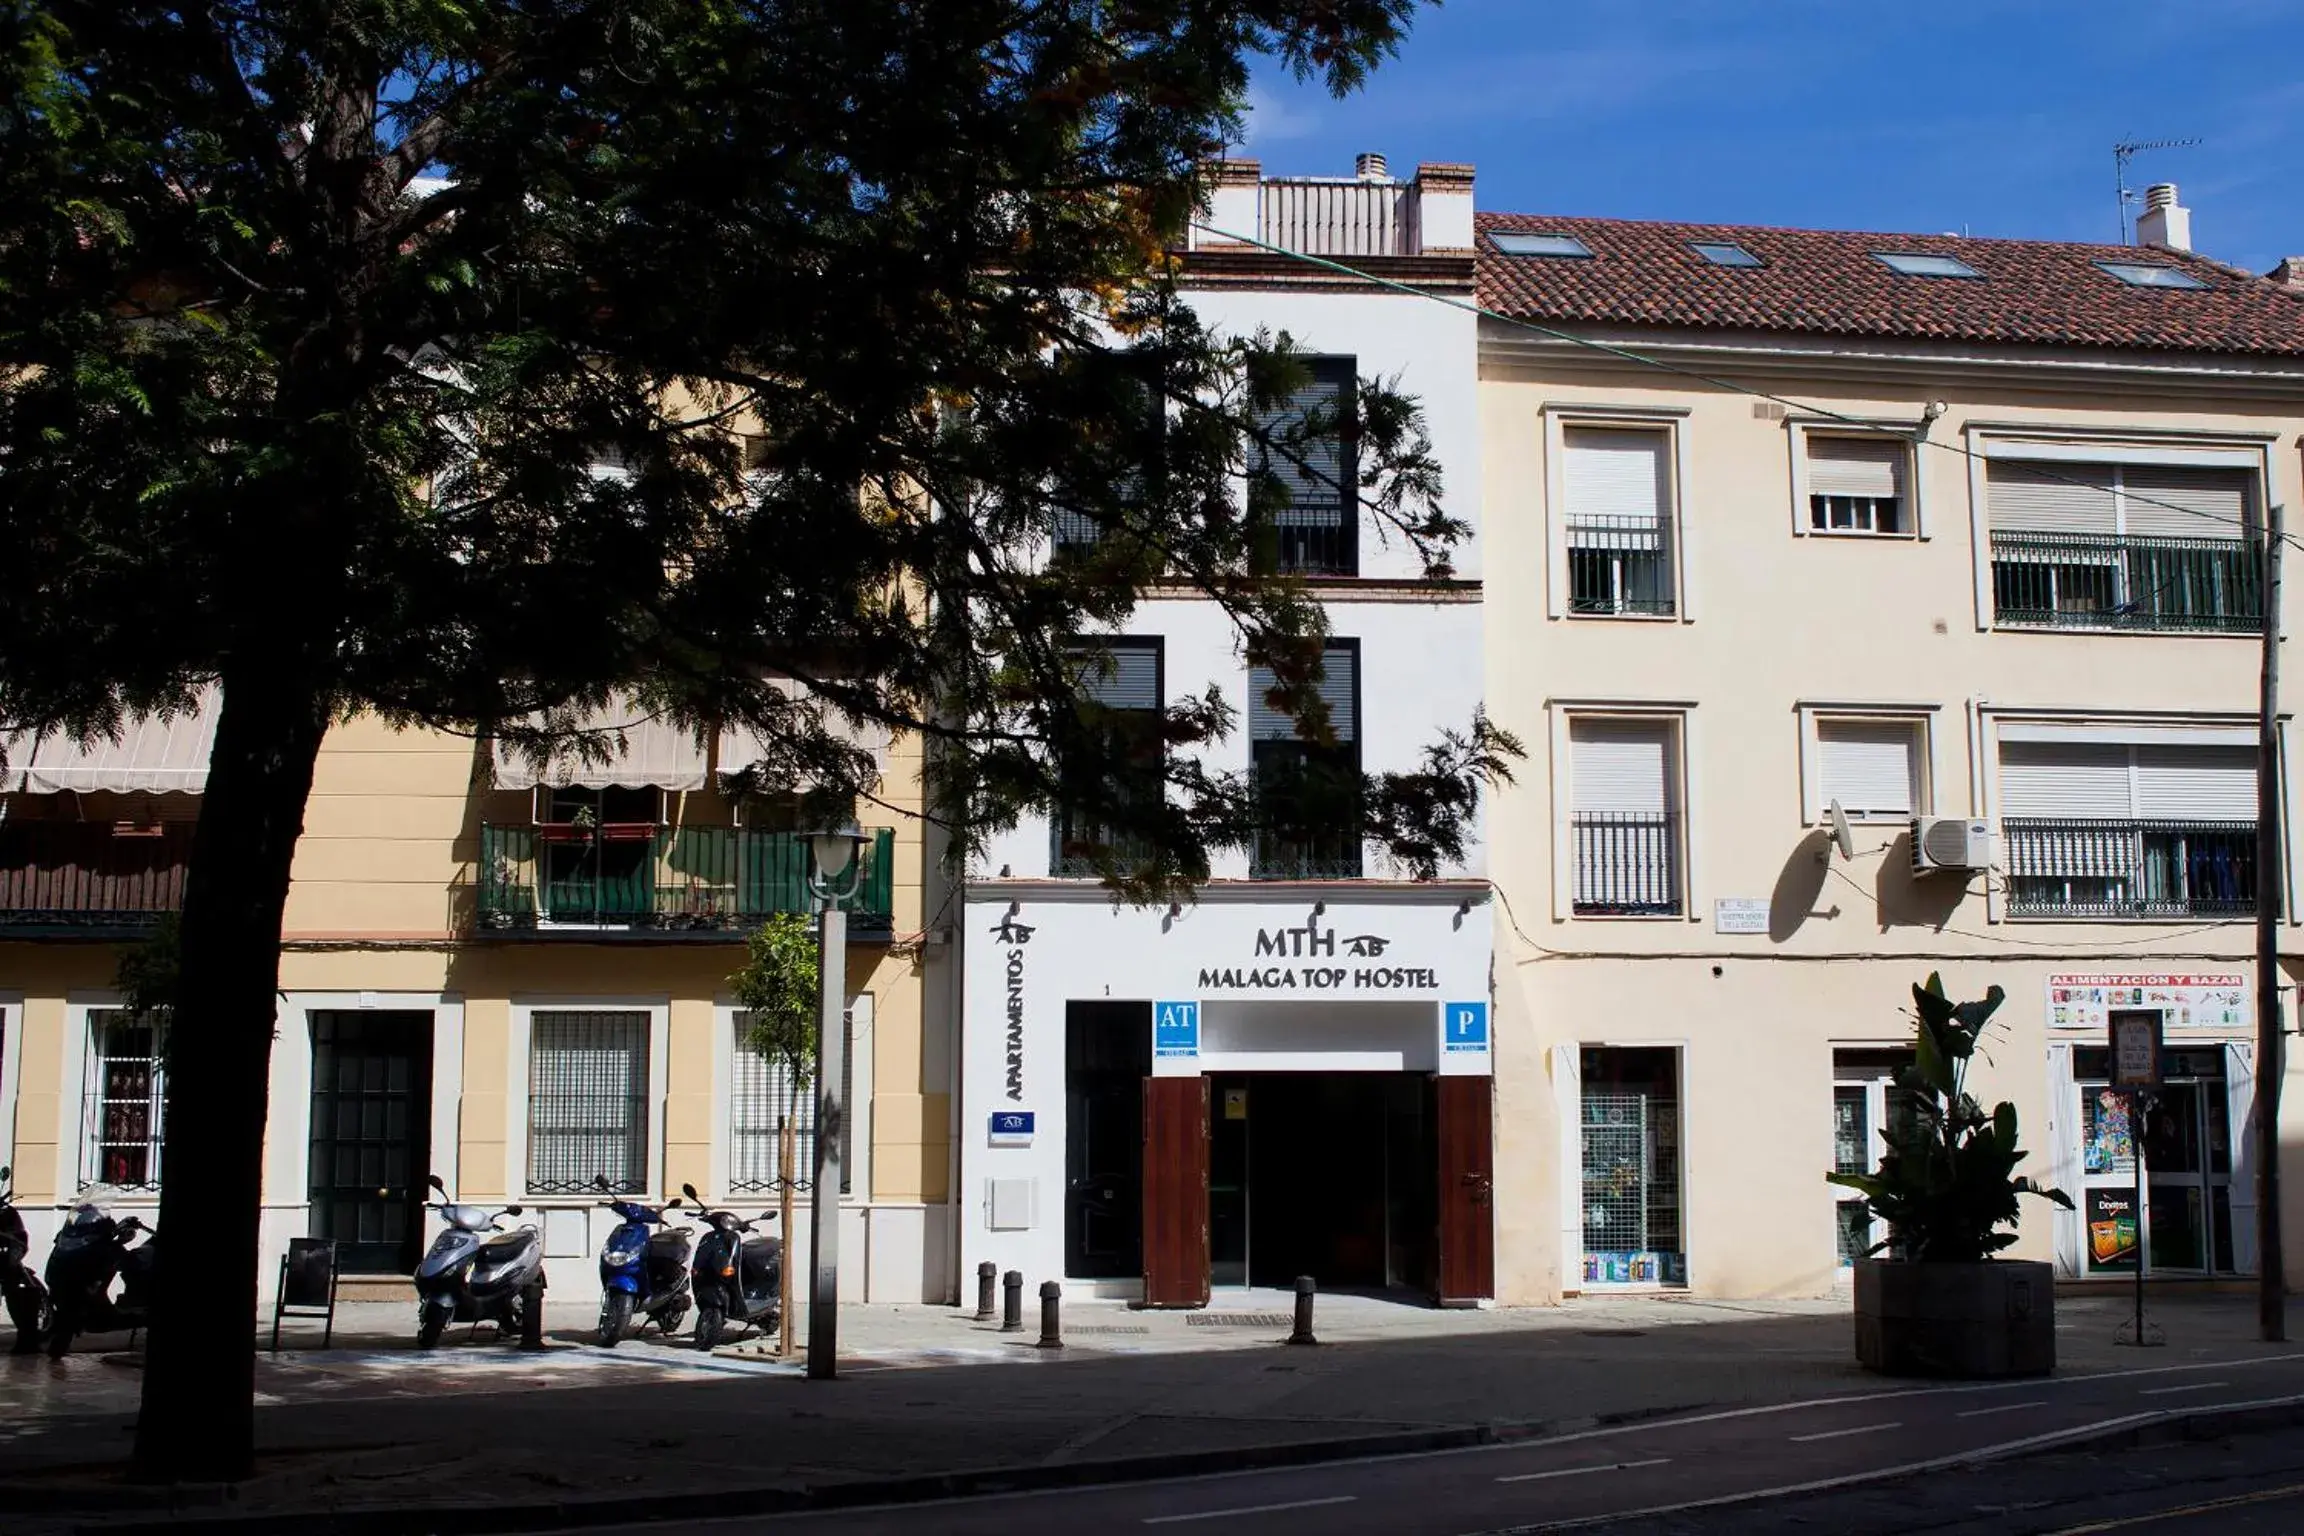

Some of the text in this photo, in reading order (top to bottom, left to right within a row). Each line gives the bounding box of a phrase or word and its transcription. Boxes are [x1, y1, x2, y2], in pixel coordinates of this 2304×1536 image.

[1255, 928, 1387, 957] MTH AB
[1198, 968, 1439, 989] MALAGA TOP HOSTEL
[2172, 975, 2185, 986] Y
[2190, 975, 2241, 986] BAZAR
[1007, 949, 1023, 1102] APARTAMENTOS
[1160, 1005, 1194, 1027] AT
[1458, 1010, 1474, 1034] P
